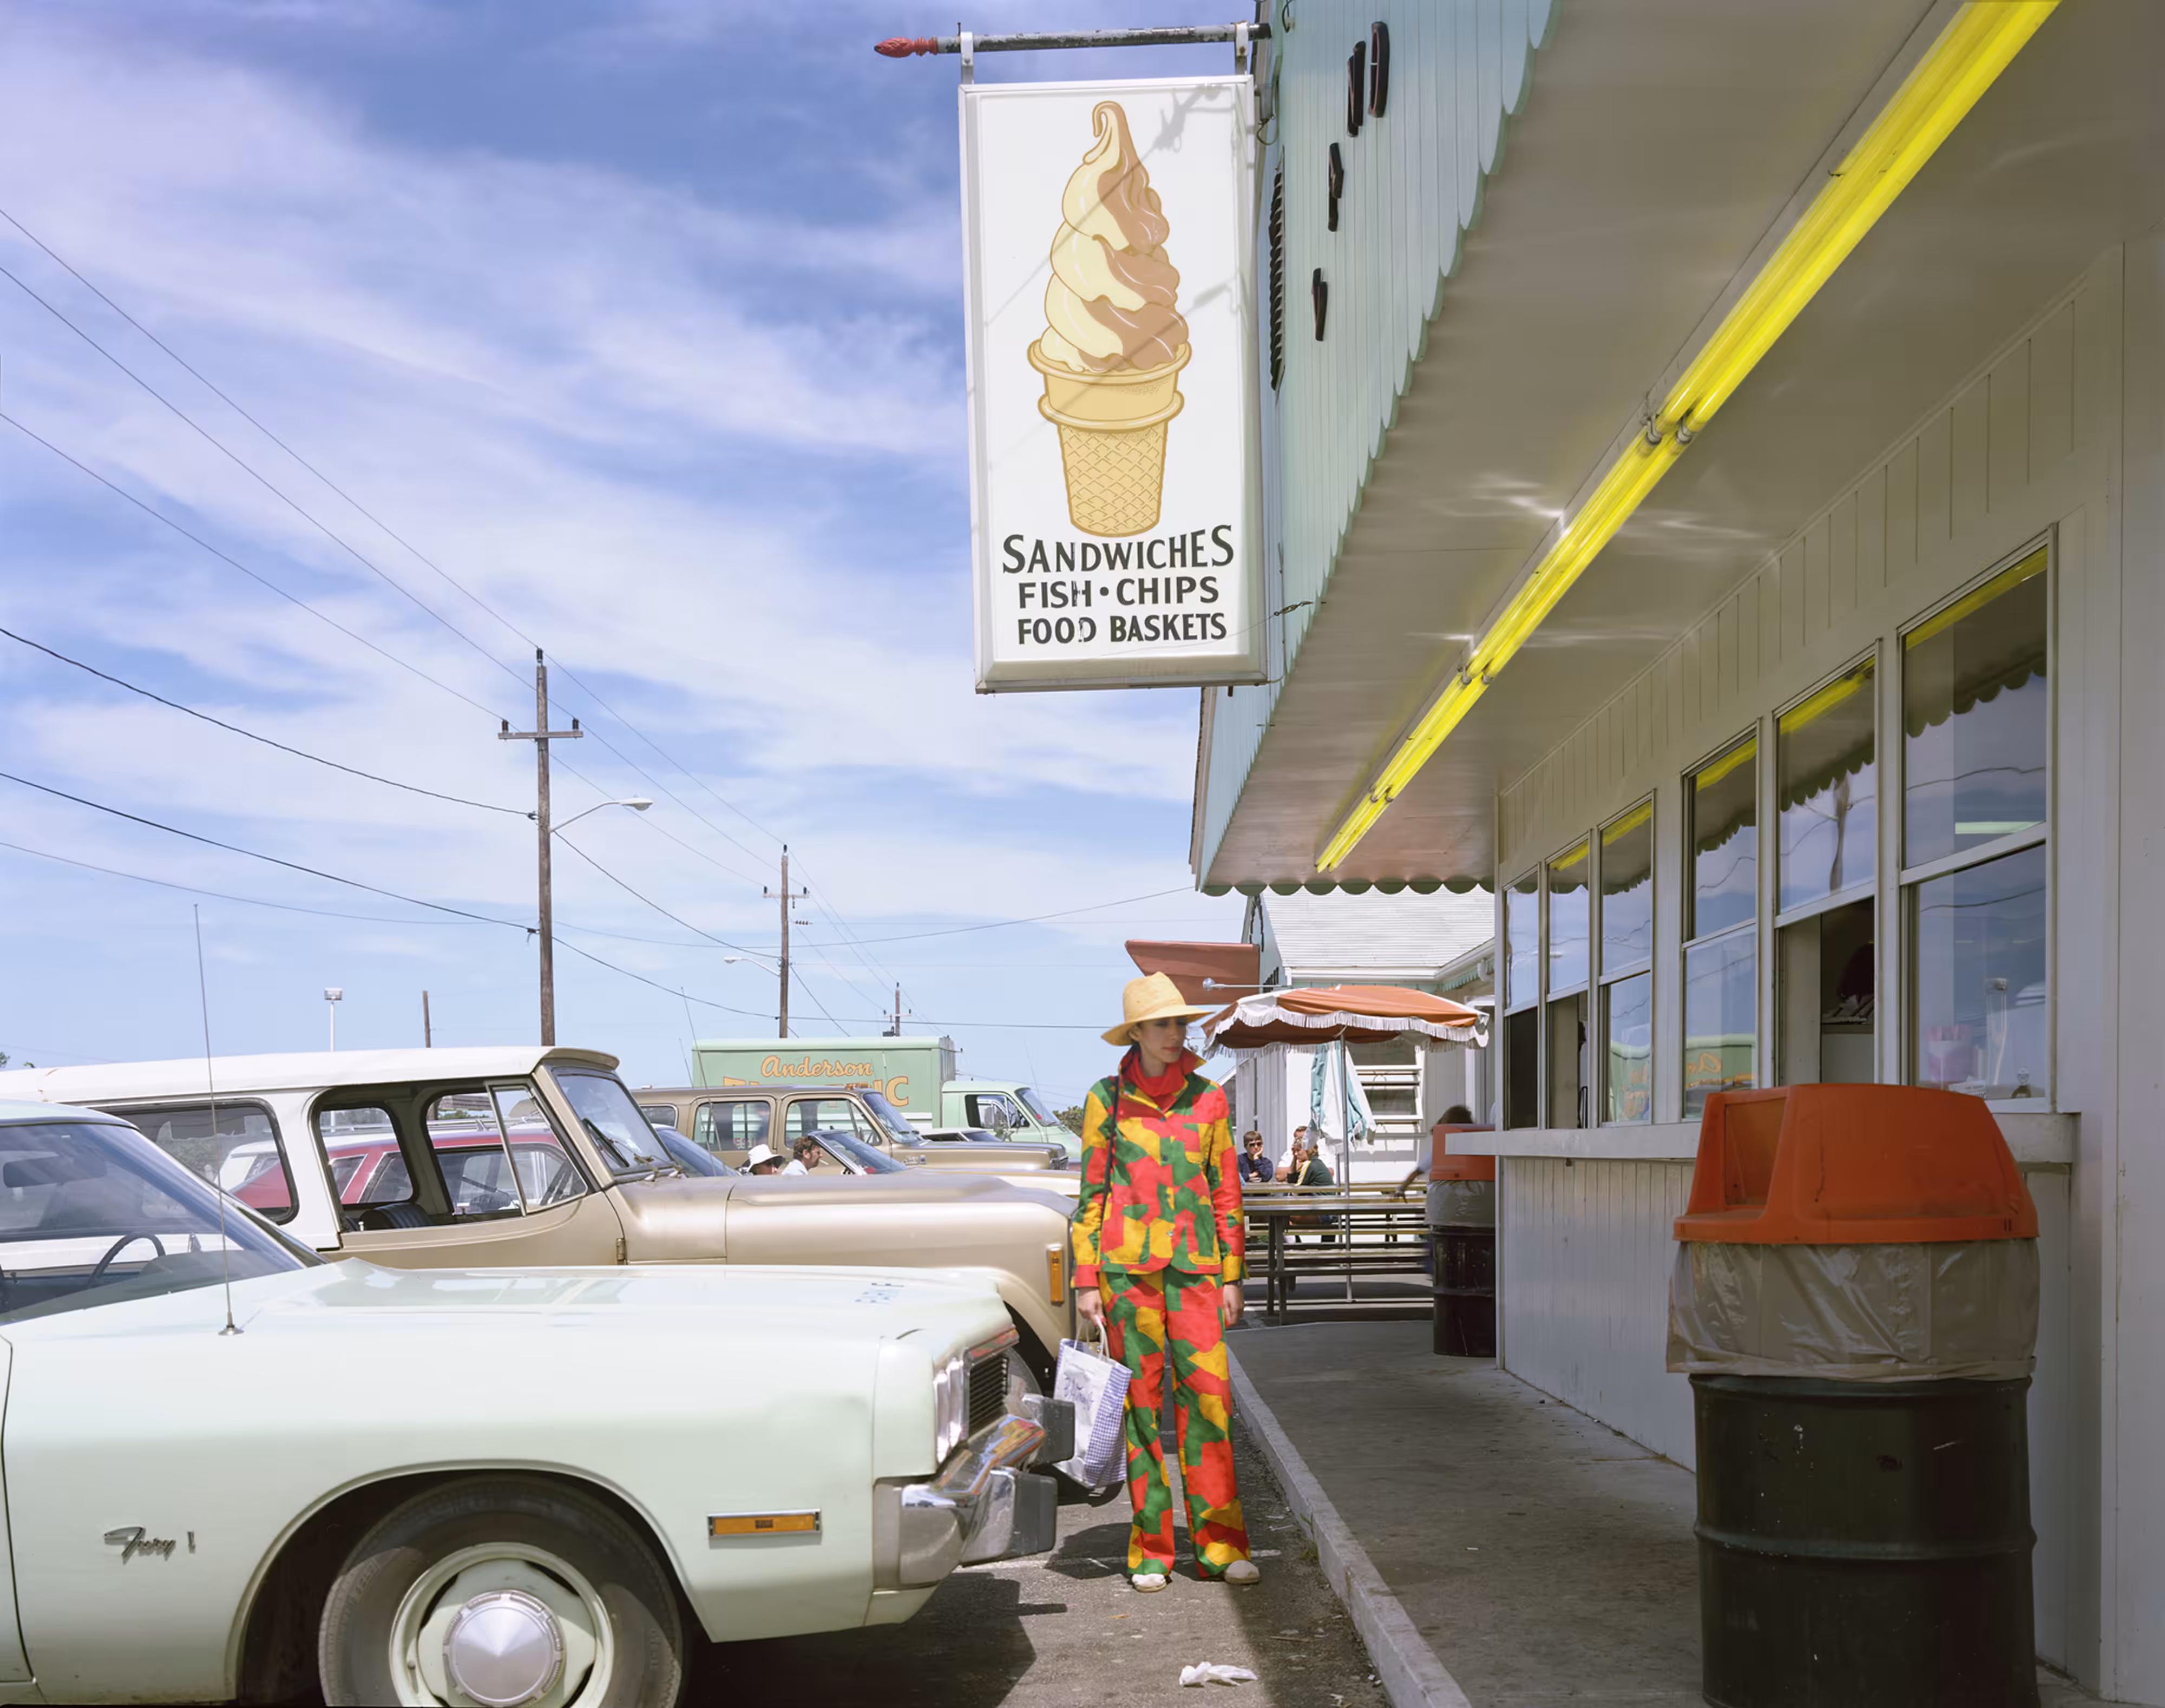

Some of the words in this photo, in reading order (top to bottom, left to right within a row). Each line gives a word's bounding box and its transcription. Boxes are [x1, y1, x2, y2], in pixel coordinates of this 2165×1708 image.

[1003, 525, 1233, 573] SANDWICHES
[1019, 581, 1091, 608] FISH
[1117, 576, 1218, 605] CHIPS
[1018, 617, 1096, 644] FOOD
[1110, 613, 1226, 642] BASKETS
[760, 1055, 874, 1078] Anderson
